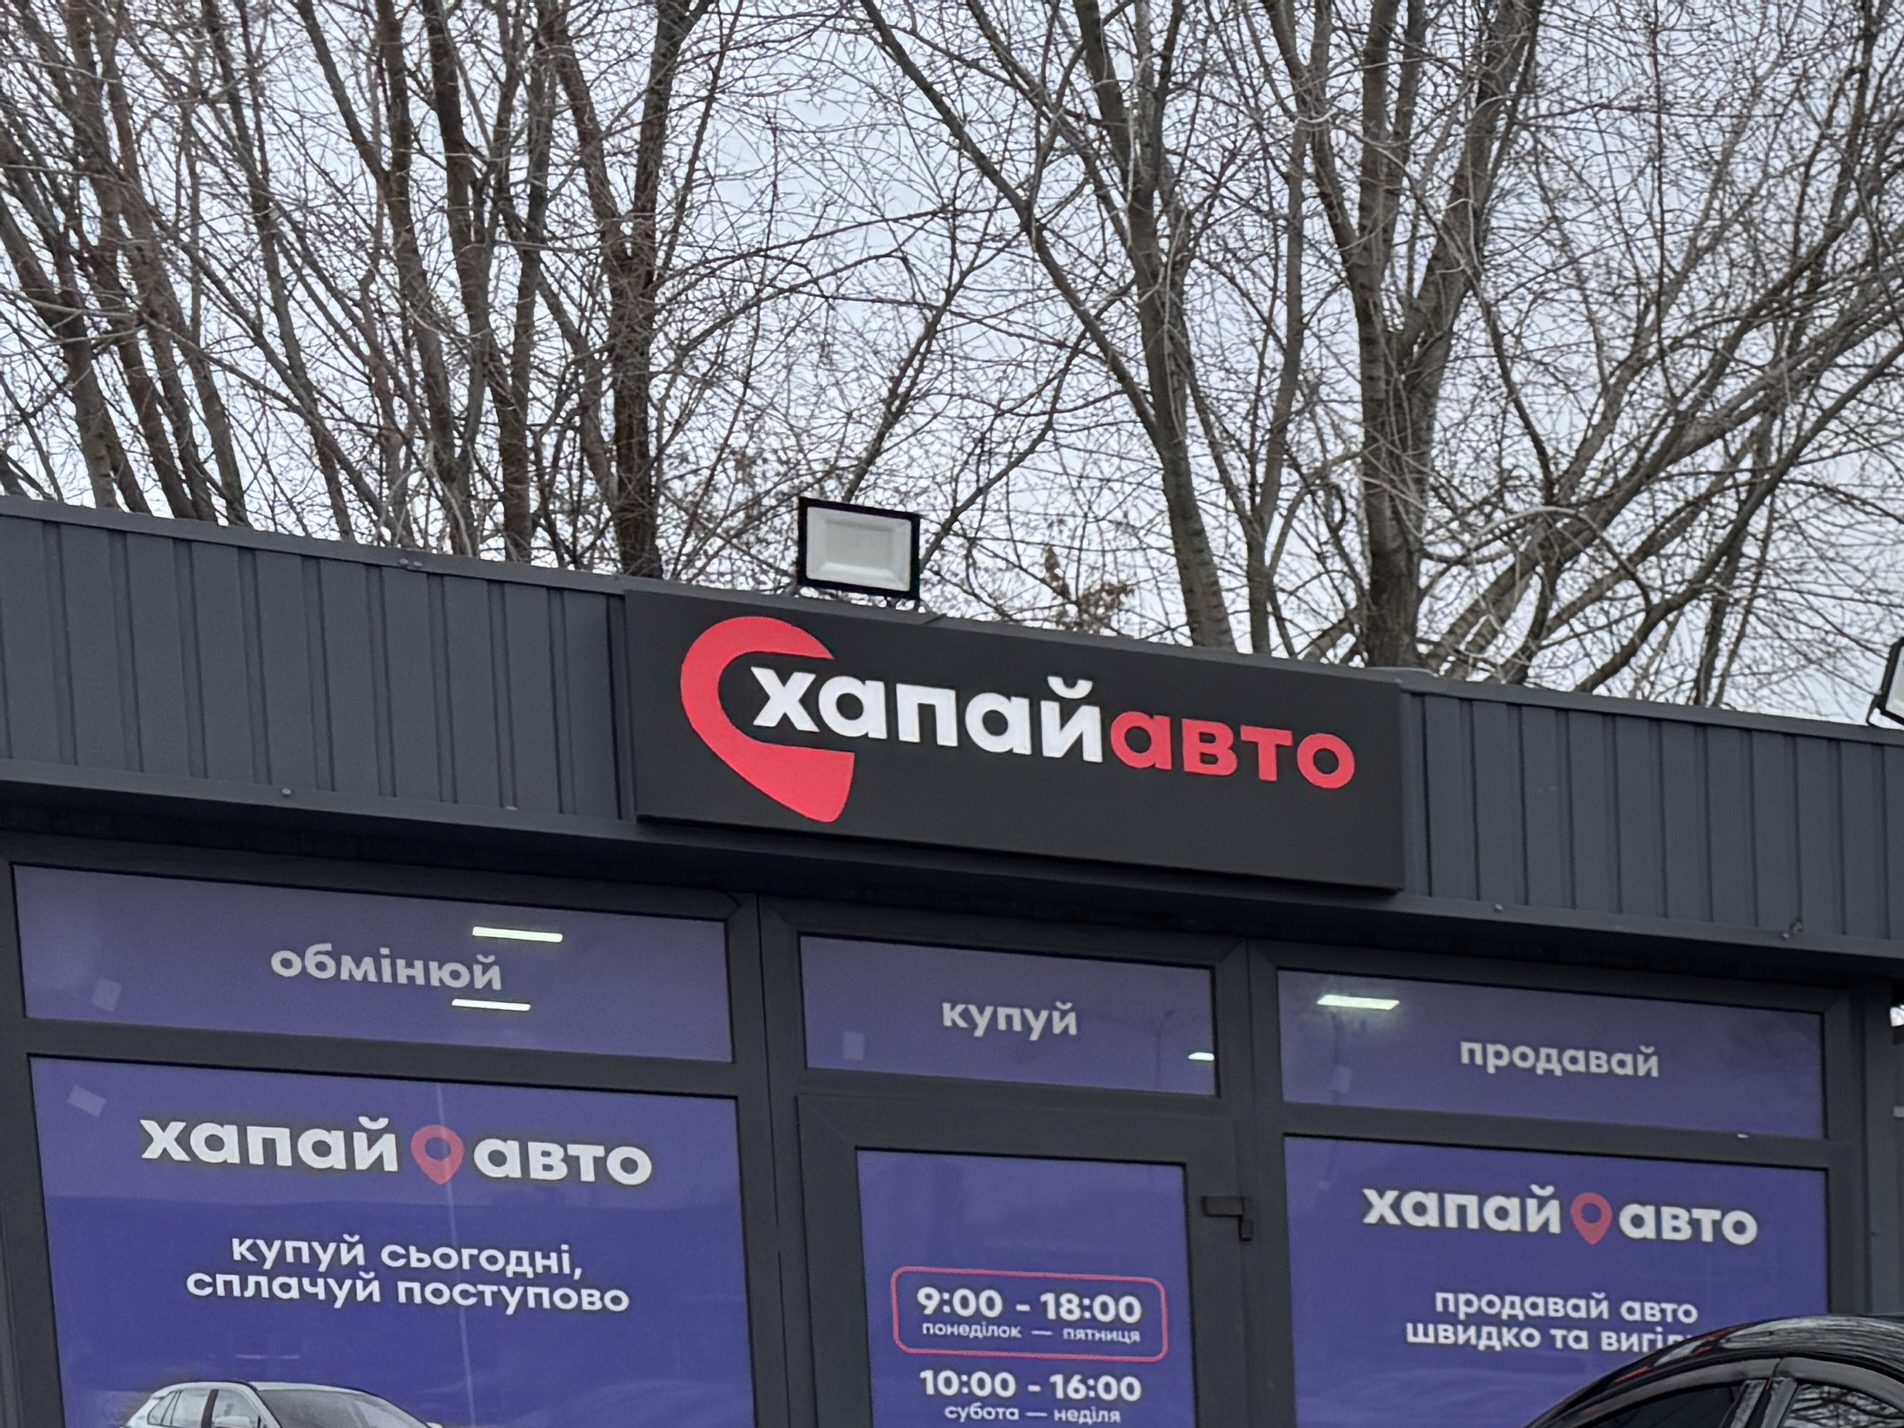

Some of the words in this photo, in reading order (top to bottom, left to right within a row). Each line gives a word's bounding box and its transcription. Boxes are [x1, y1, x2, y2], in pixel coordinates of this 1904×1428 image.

[271, 943, 502, 990] обмінюй
[942, 1001, 1078, 1041] купуй
[1460, 1038, 1660, 1078] продавай
[139, 1116, 399, 1173] хапай
[474, 1135, 653, 1186] авто
[1362, 1185, 1561, 1233] хапай
[1618, 1208, 1758, 1245] авто
[231, 1233, 365, 1272] купуй
[380, 1241, 583, 1280] сьогодні,
[187, 1267, 381, 1309] сплачуй
[398, 1280, 630, 1314] поступово
[916, 1286, 1003, 1317] 9:00
[1040, 1293, 1142, 1324] 18:00
[1434, 1291, 1609, 1321] продавай
[1620, 1298, 1698, 1324] авто
[922, 1321, 1022, 1340] понеділок
[1063, 1328, 1141, 1344] пятниця
[1406, 1323, 1541, 1351] швидко
[1550, 1328, 1588, 1349] та
[919, 1370, 1016, 1397] 10:00
[1049, 1374, 1142, 1401] 16:00
[944, 1402, 1020, 1423] субота
[1054, 1406, 1121, 1424] неділя
